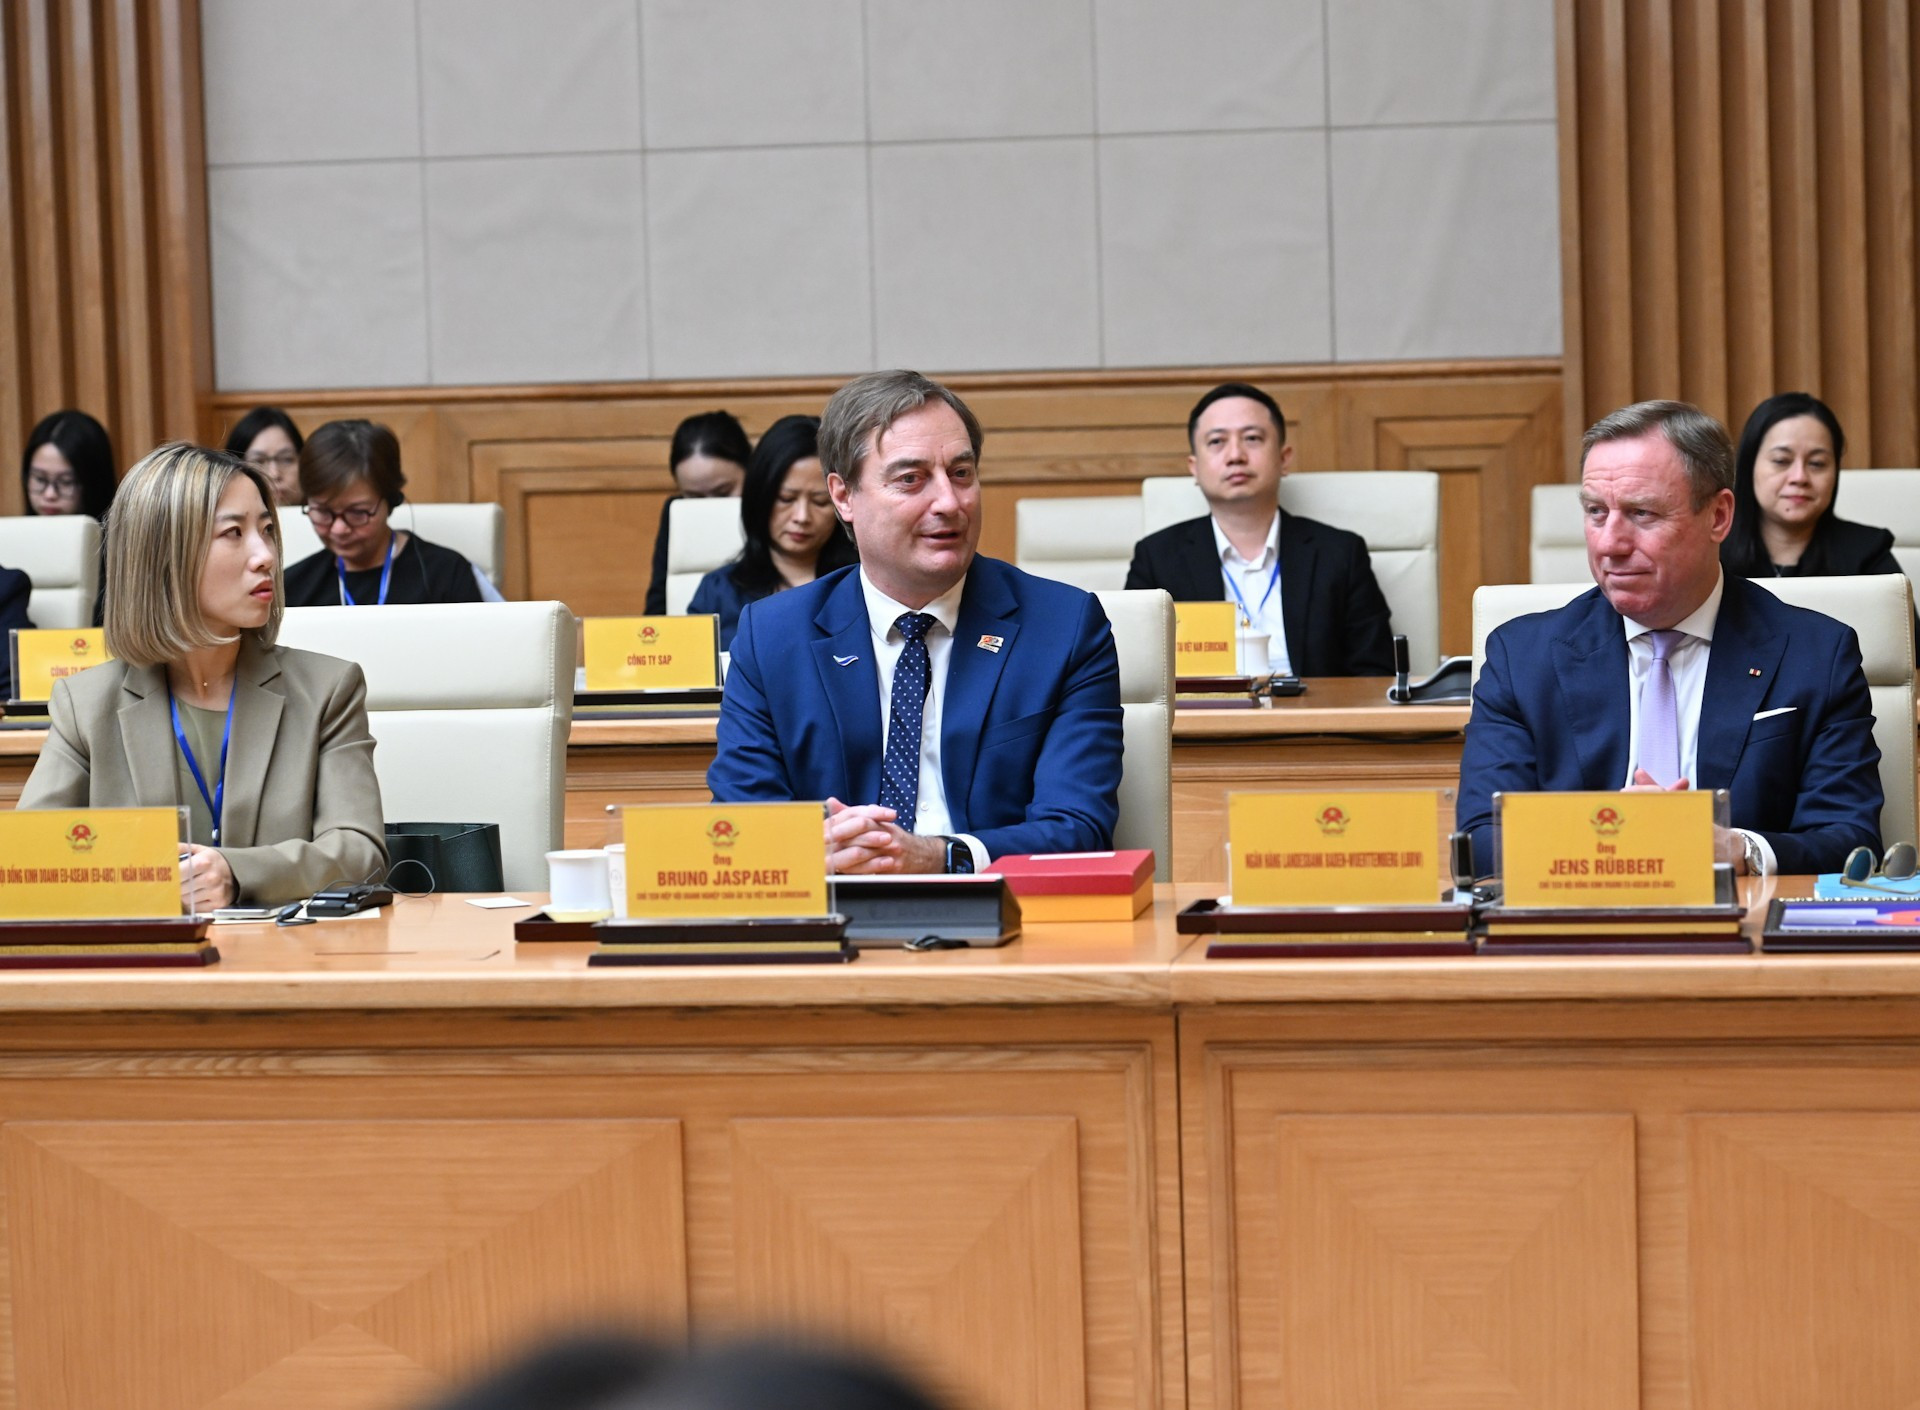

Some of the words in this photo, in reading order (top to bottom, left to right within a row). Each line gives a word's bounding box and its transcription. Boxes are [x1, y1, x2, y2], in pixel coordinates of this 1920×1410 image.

[627, 653, 646, 666] CÔNG
[648, 655, 656, 666] TY
[658, 654, 672, 665] SAP
[51, 664, 69, 677] CÔNG
[1596, 841, 1616, 855] Ông
[713, 853, 732, 866] Ông
[1549, 859, 1589, 875] JENS
[1595, 856, 1665, 875] RÜBBERT
[24, 867, 38, 884] KINH
[39, 867, 59, 884] DOANH
[60, 867, 89, 884] EU-ASEAN
[657, 871, 708, 887] BRUNO
[713, 869, 789, 886] JASPAERT
